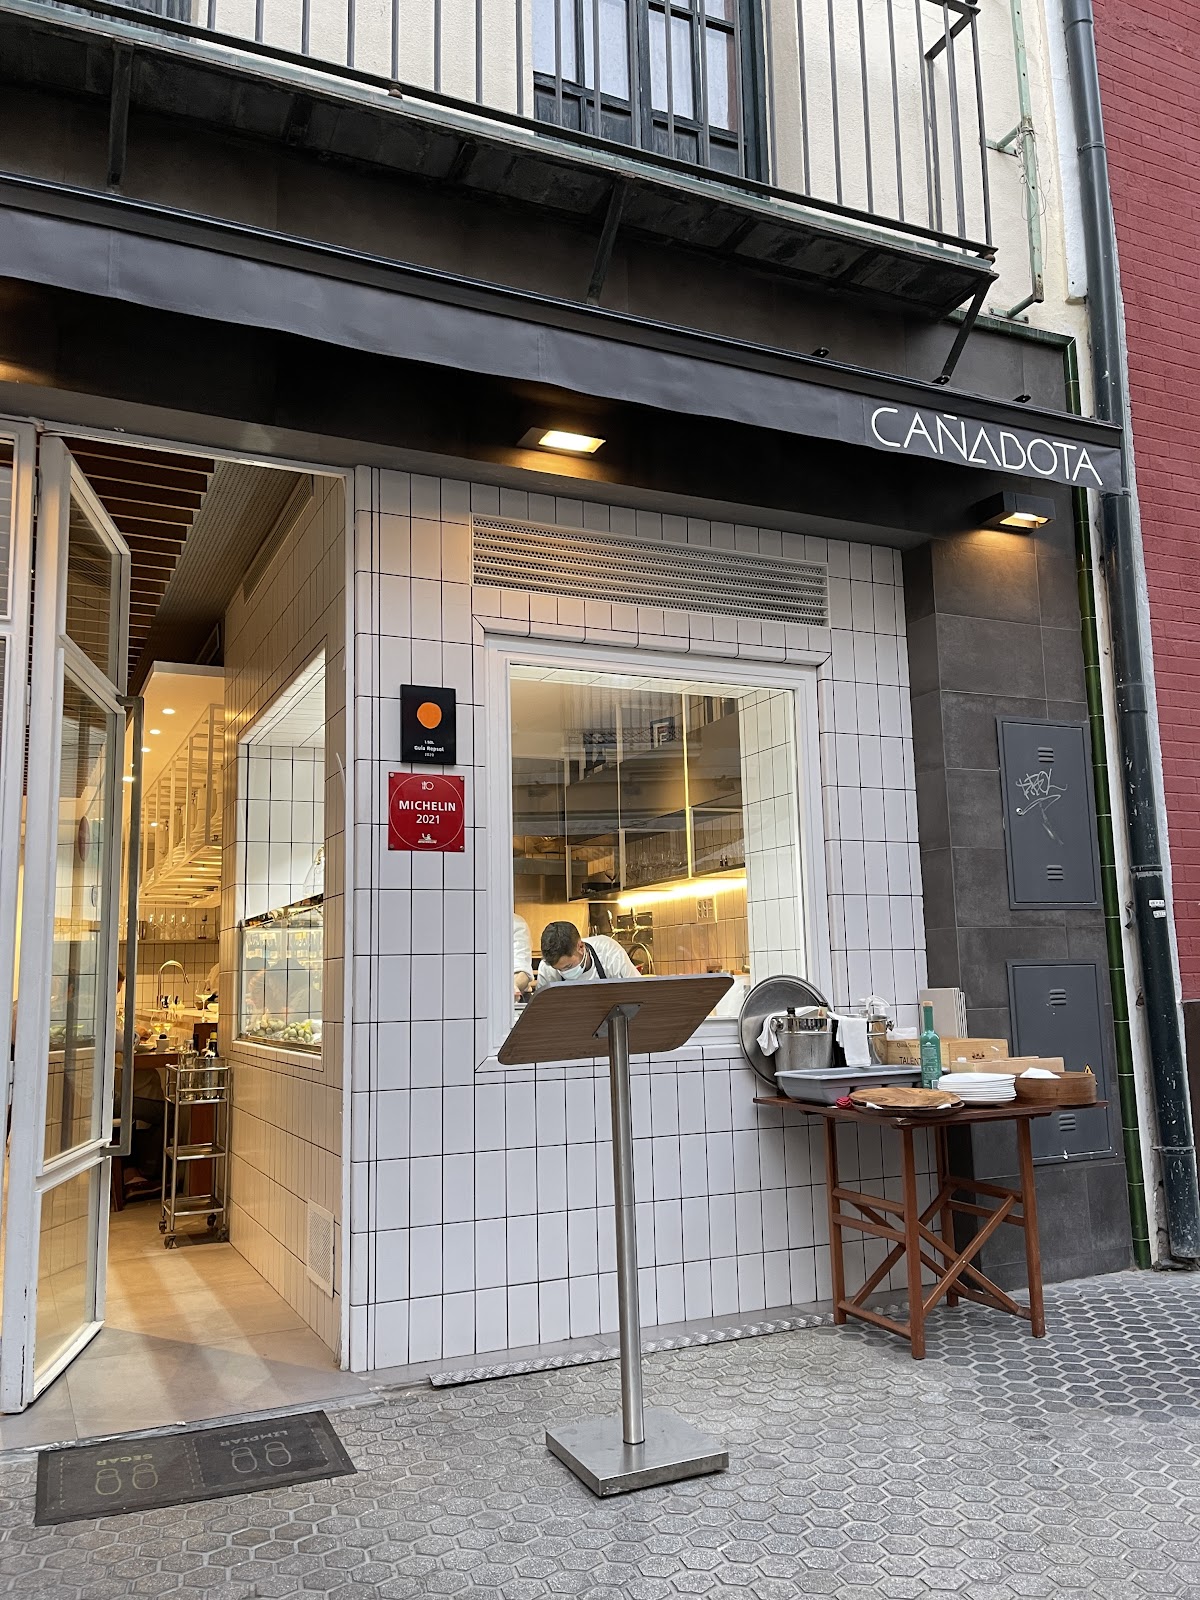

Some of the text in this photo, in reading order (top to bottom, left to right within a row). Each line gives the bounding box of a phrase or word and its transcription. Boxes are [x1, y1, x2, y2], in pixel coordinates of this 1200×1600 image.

[871, 407, 1103, 486] CAÑABOTA
[399, 800, 456, 812] MICHELIN
[416, 814, 440, 824] 2021
[220, 1430, 288, 1446] LIMPIAR
[96, 1454, 153, 1465] SECAR
